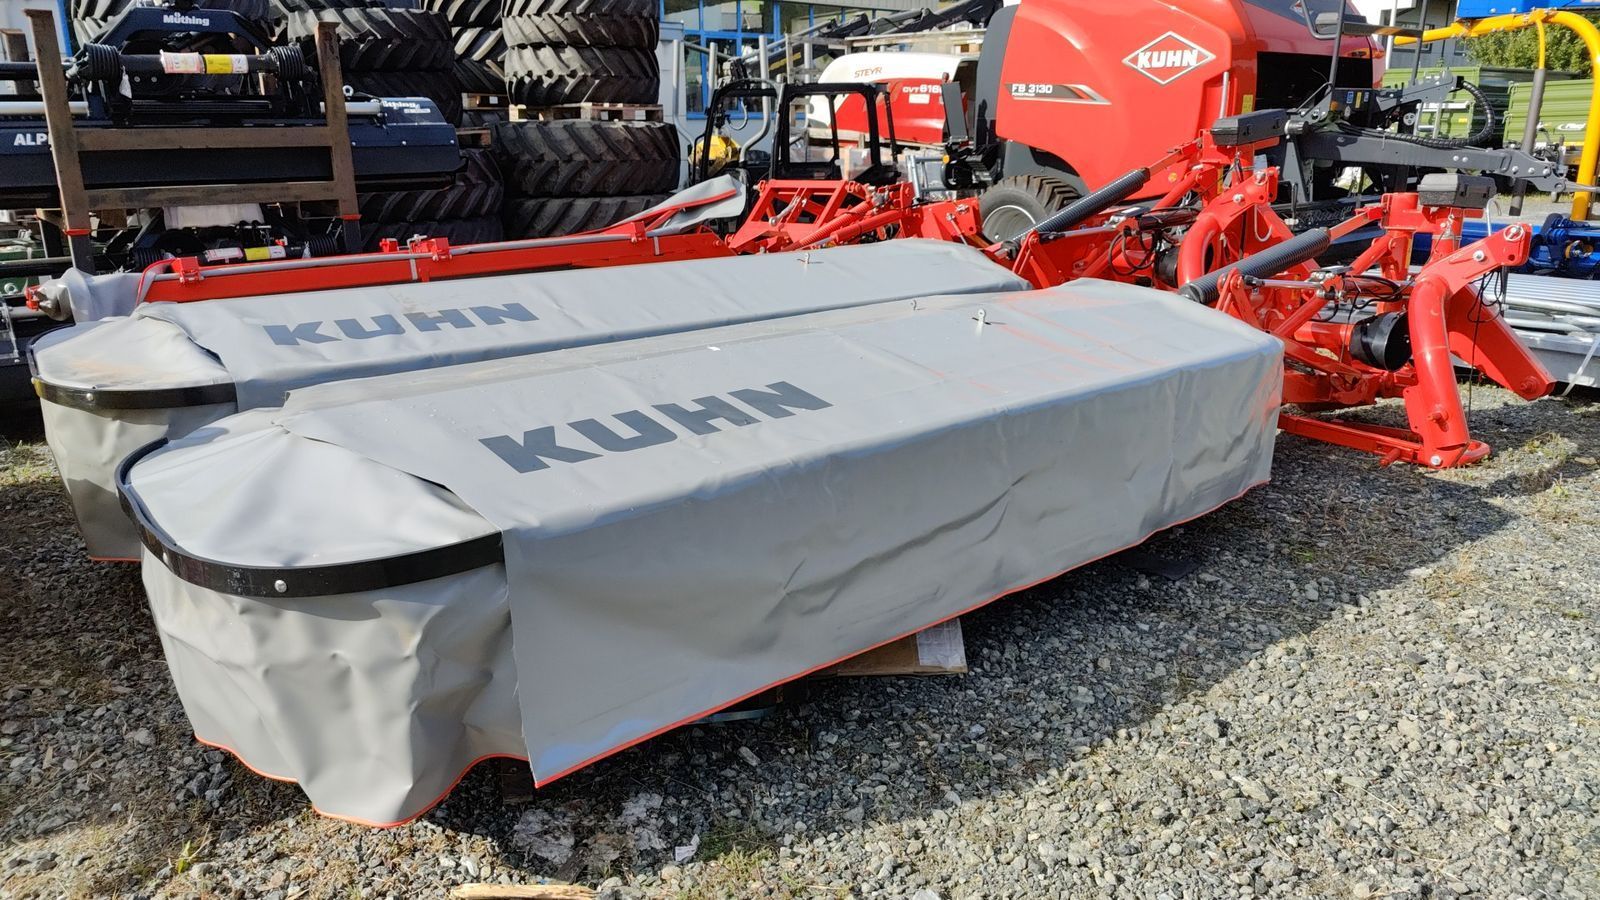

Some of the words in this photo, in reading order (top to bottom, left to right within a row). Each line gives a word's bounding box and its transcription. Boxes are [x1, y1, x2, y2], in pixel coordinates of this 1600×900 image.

[1137, 49, 1198, 69] KUHN
[854, 66, 882, 79] STEYR
[1012, 83, 1026, 93] FB
[1028, 84, 1053, 94] 3130
[262, 303, 539, 346] KUHN
[478, 381, 834, 474] KUHN
